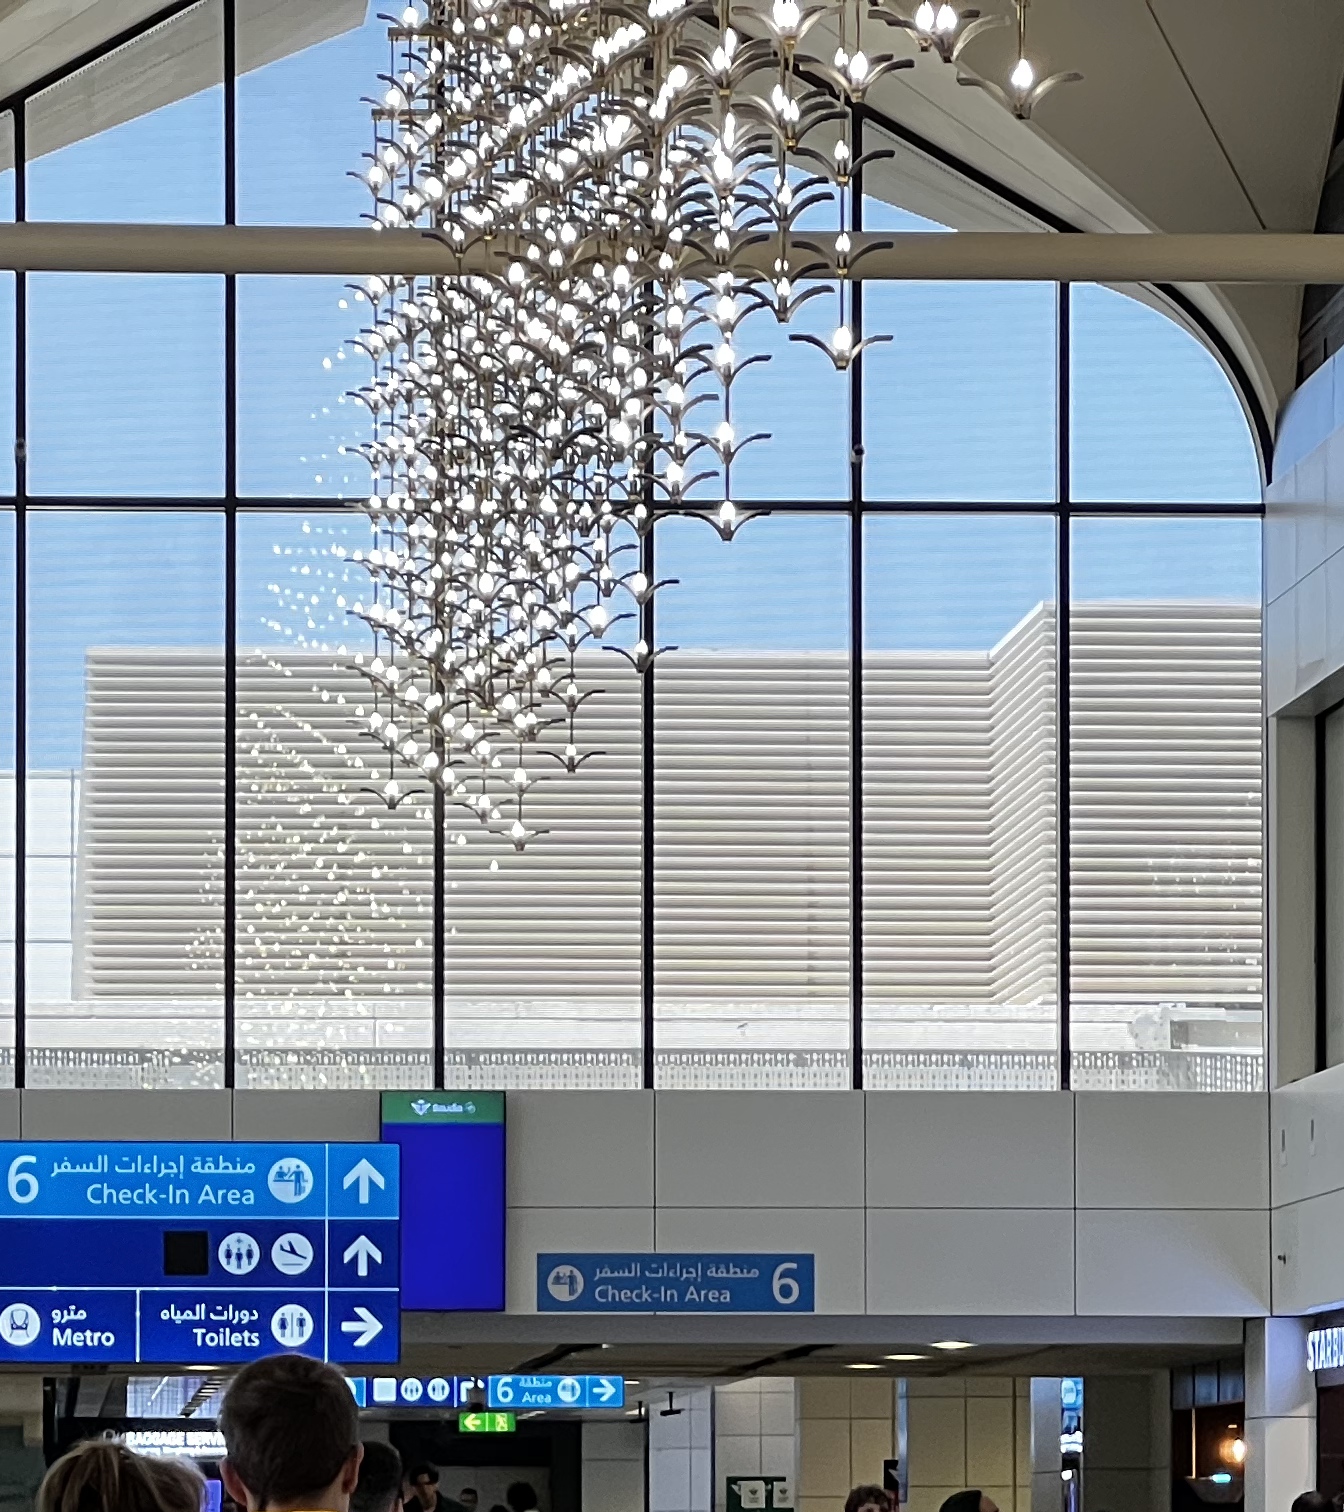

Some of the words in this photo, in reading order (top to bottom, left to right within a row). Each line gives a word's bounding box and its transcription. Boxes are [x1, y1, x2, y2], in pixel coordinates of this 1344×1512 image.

[51, 1154, 109, 1178] السفر
[114, 1155, 184, 1180] إجراءات
[191, 1154, 256, 1175] منطقة
[6, 1154, 41, 1205] 6
[86, 1183, 190, 1206] Check-In
[200, 1184, 256, 1206] Area
[593, 1262, 641, 1282] السفر
[644, 1262, 702, 1283] إجراءات
[706, 1262, 760, 1279] منطقة
[594, 1284, 678, 1304] Check-In
[684, 1286, 731, 1304] Area
[771, 1262, 800, 1305] 6
[51, 1307, 87, 1324] مترو
[159, 1304, 208, 1324] المياه
[209, 1306, 259, 1324] دورات
[52, 1327, 115, 1347] Metro
[192, 1326, 260, 1348] Toilets
[496, 1377, 514, 1404] 6
[521, 1391, 552, 1404] Area
